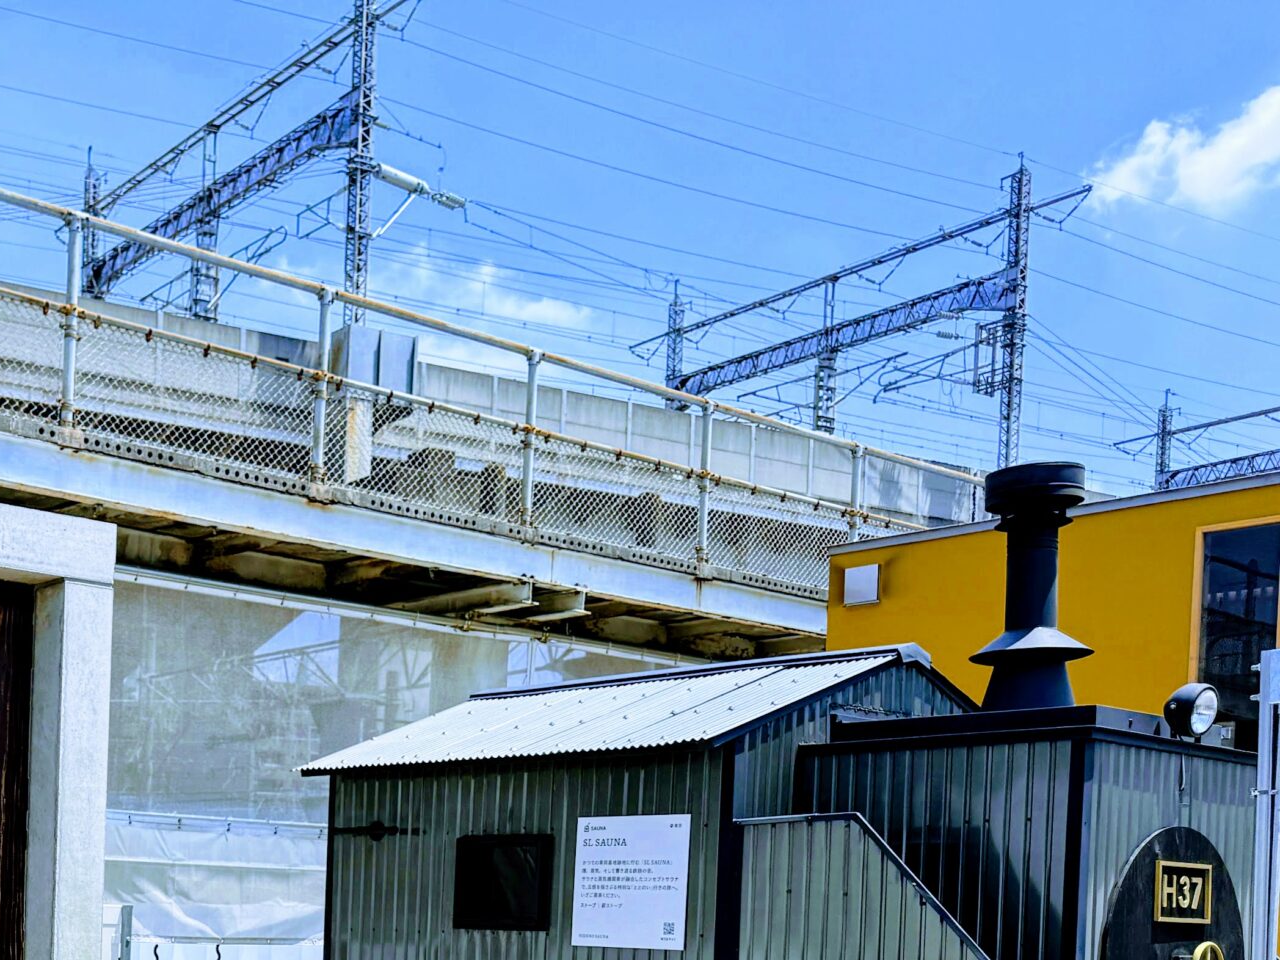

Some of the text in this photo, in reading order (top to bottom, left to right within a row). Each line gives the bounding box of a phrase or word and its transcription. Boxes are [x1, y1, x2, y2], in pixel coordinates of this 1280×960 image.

[582, 837, 628, 847] SL SAUNA
[1162, 874, 1204, 910] H37
